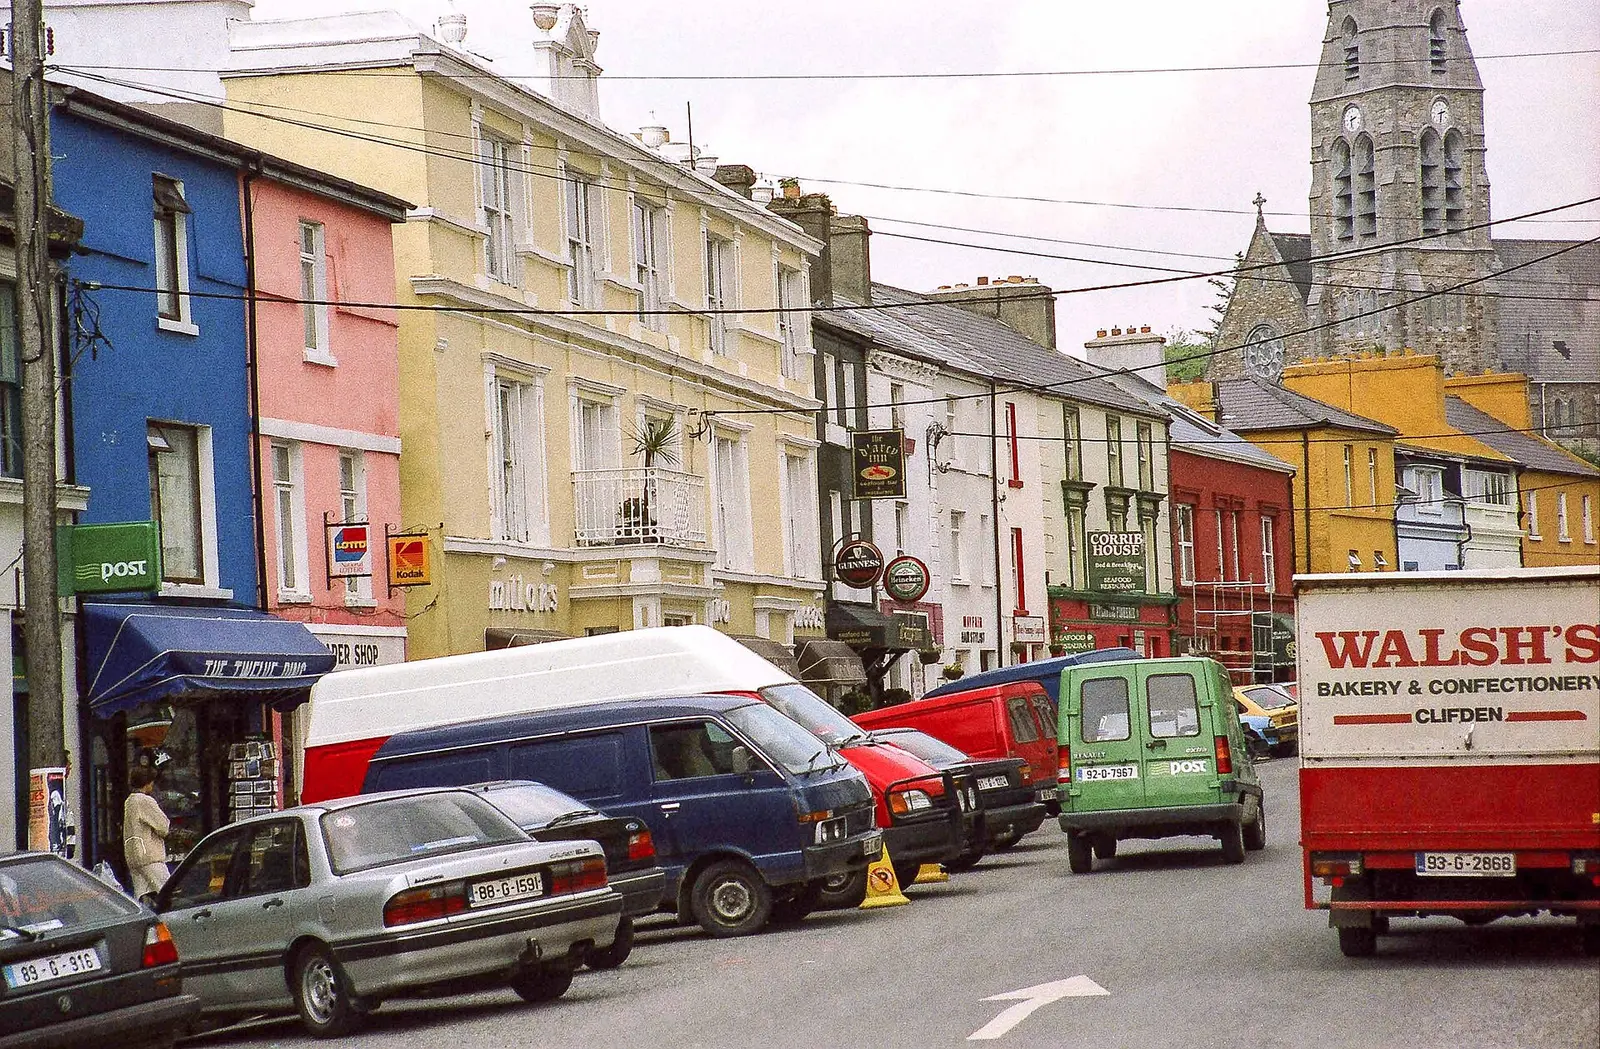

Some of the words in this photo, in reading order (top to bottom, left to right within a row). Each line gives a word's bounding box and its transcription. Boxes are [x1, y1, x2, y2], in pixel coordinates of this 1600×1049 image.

[1090, 533, 1143, 545] CORRIB
[336, 541, 366, 550] LOTTO
[1092, 544, 1140, 556] HOUSE
[838, 559, 881, 570] GUINNESS
[396, 570, 424, 579] Kodak
[890, 575, 922, 584] Heineken
[1315, 624, 1600, 668] WALSH'S
[354, 643, 379, 666] SHOP
[1317, 681, 1402, 697] BAKERY
[1408, 680, 1423, 695] &
[1429, 675, 1600, 695] CONFECTIONERY
[1415, 706, 1503, 724] CLIFDEN
[1073, 751, 1106, 759] RENAULT
[1427, 855, 1512, 871] 93-G-2868
[478, 876, 540, 900] 88-G-1591
